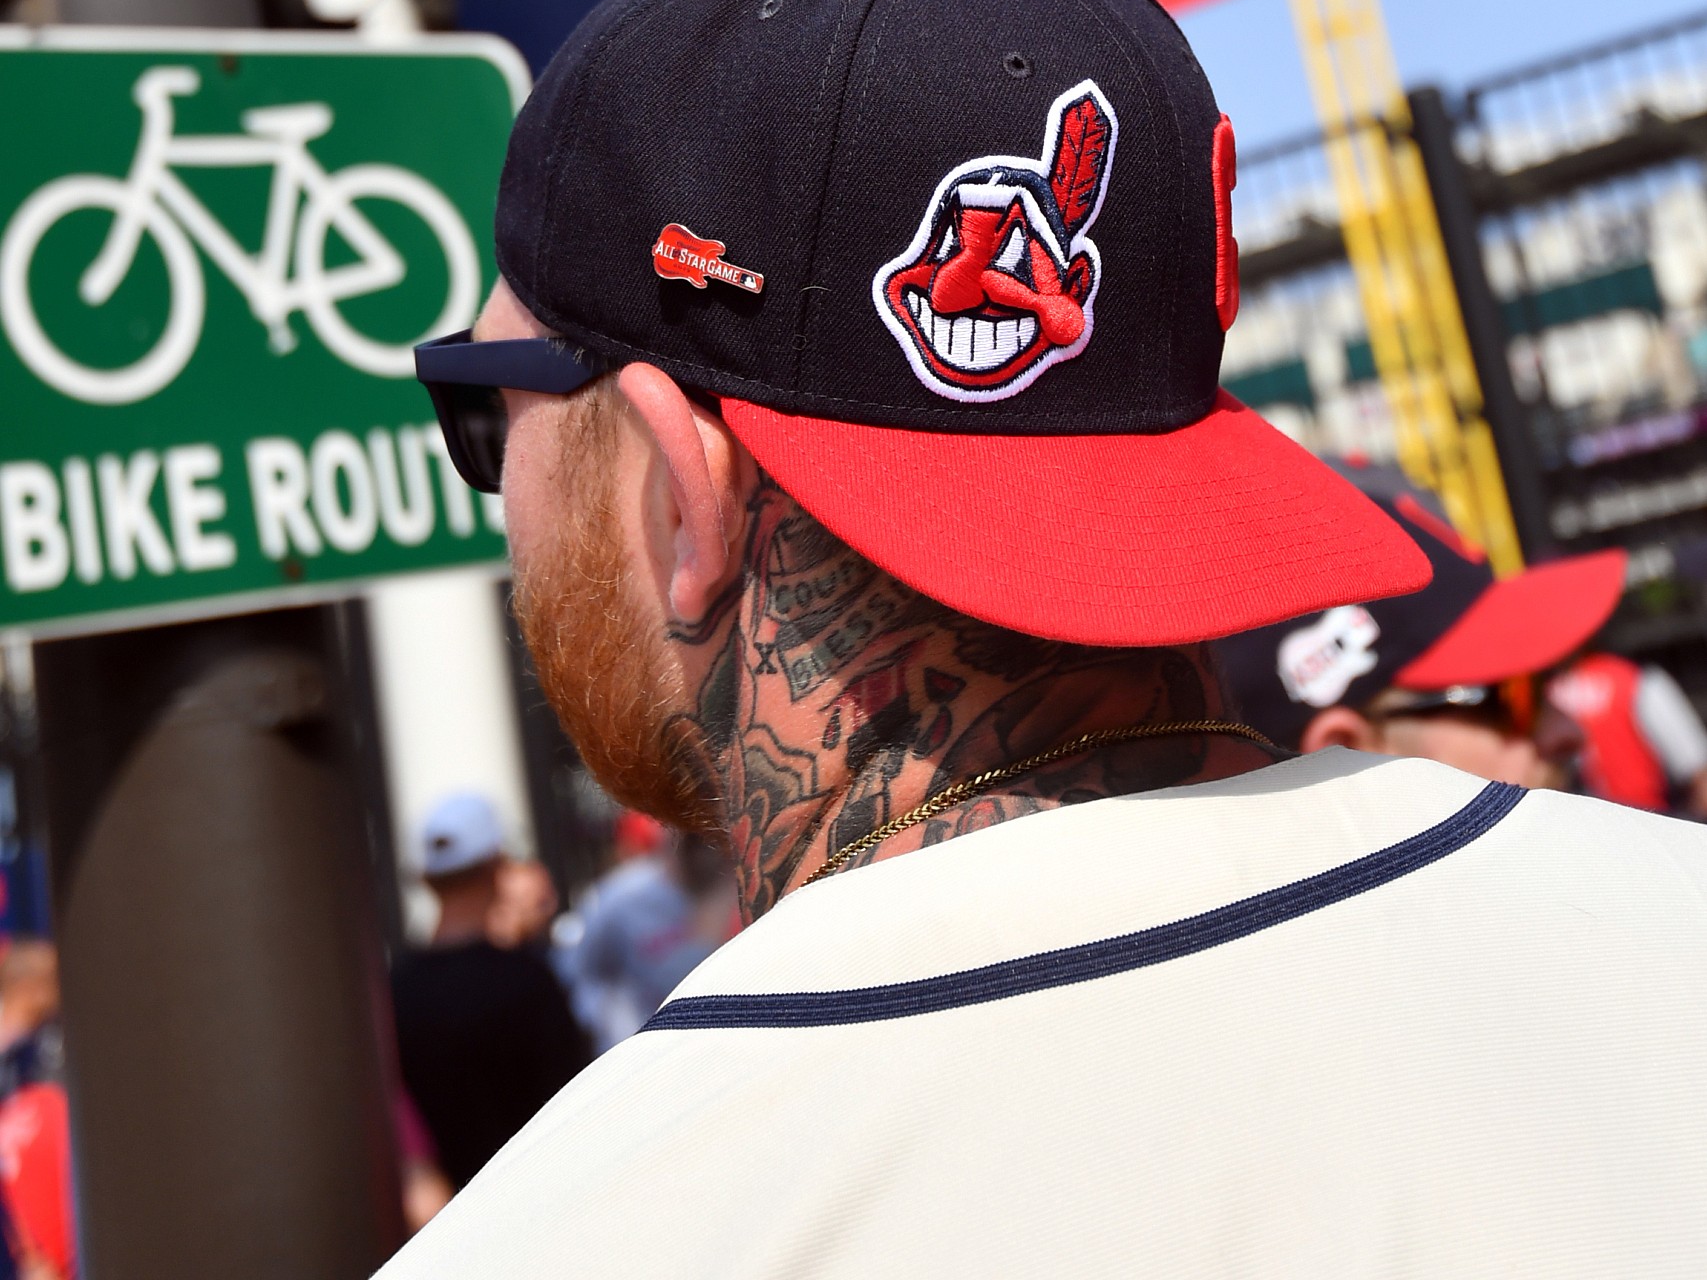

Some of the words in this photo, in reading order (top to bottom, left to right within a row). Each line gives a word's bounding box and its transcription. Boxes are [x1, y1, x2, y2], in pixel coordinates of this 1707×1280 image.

[655, 241, 676, 260] ALL
[679, 248, 707, 272] STAR
[707, 260, 740, 282] GAME
[0, 443, 237, 594] BIKE
[245, 422, 506, 561] ROUT
